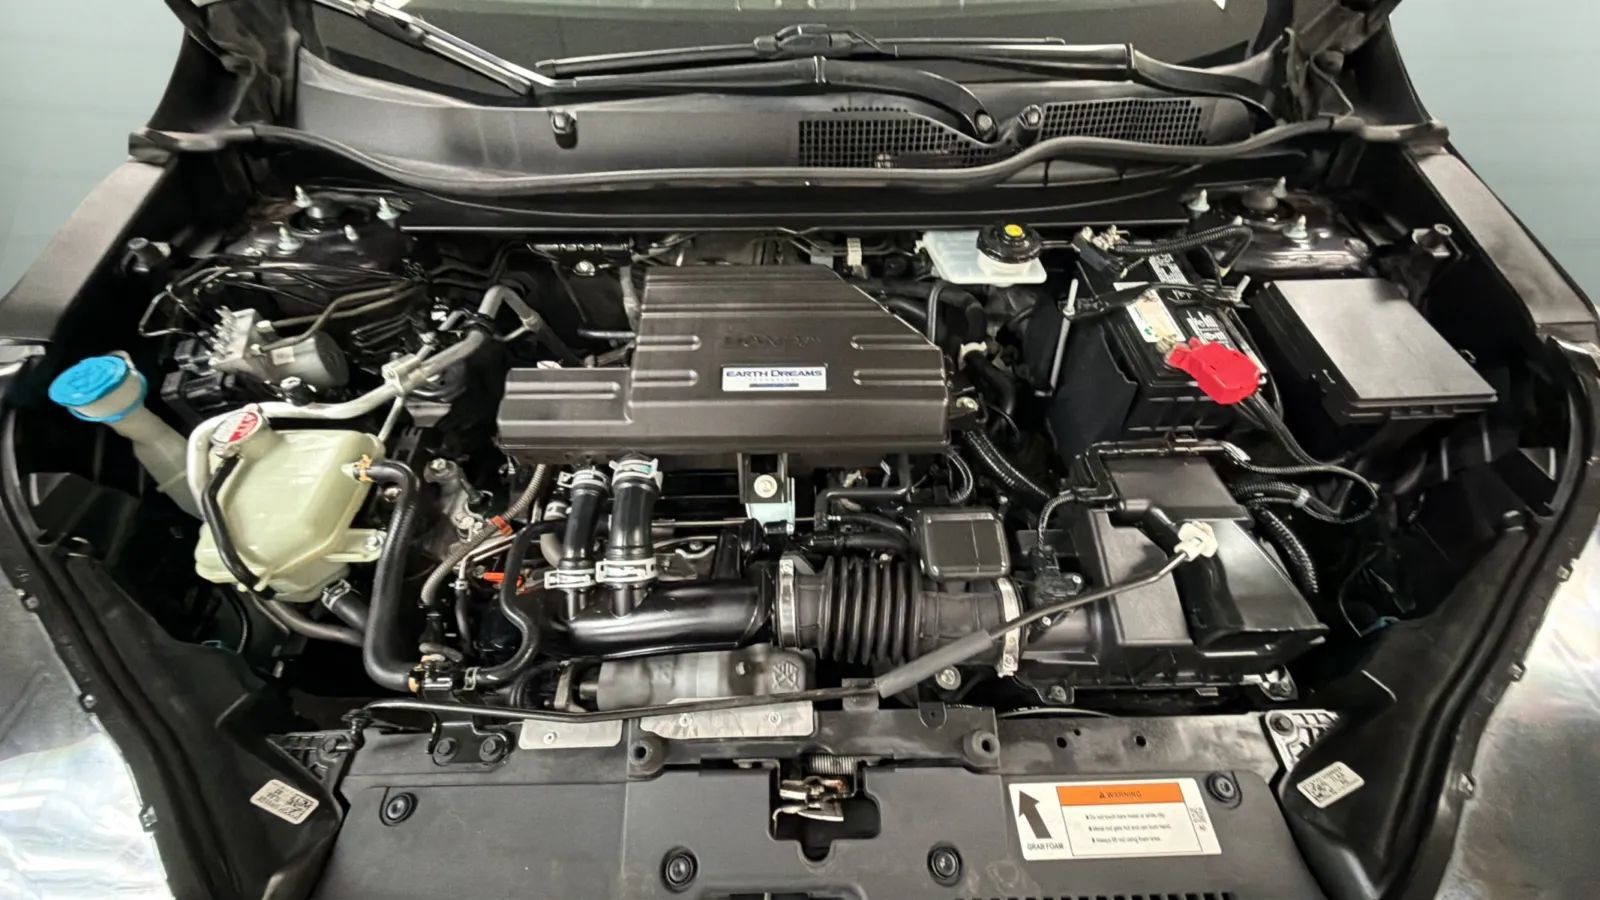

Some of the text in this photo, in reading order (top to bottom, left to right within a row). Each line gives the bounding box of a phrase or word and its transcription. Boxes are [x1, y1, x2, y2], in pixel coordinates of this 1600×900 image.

[771, 369, 822, 377] DREAMS
[1106, 791, 1142, 799] WARNING
[1027, 841, 1065, 850] GRAB FOAM
